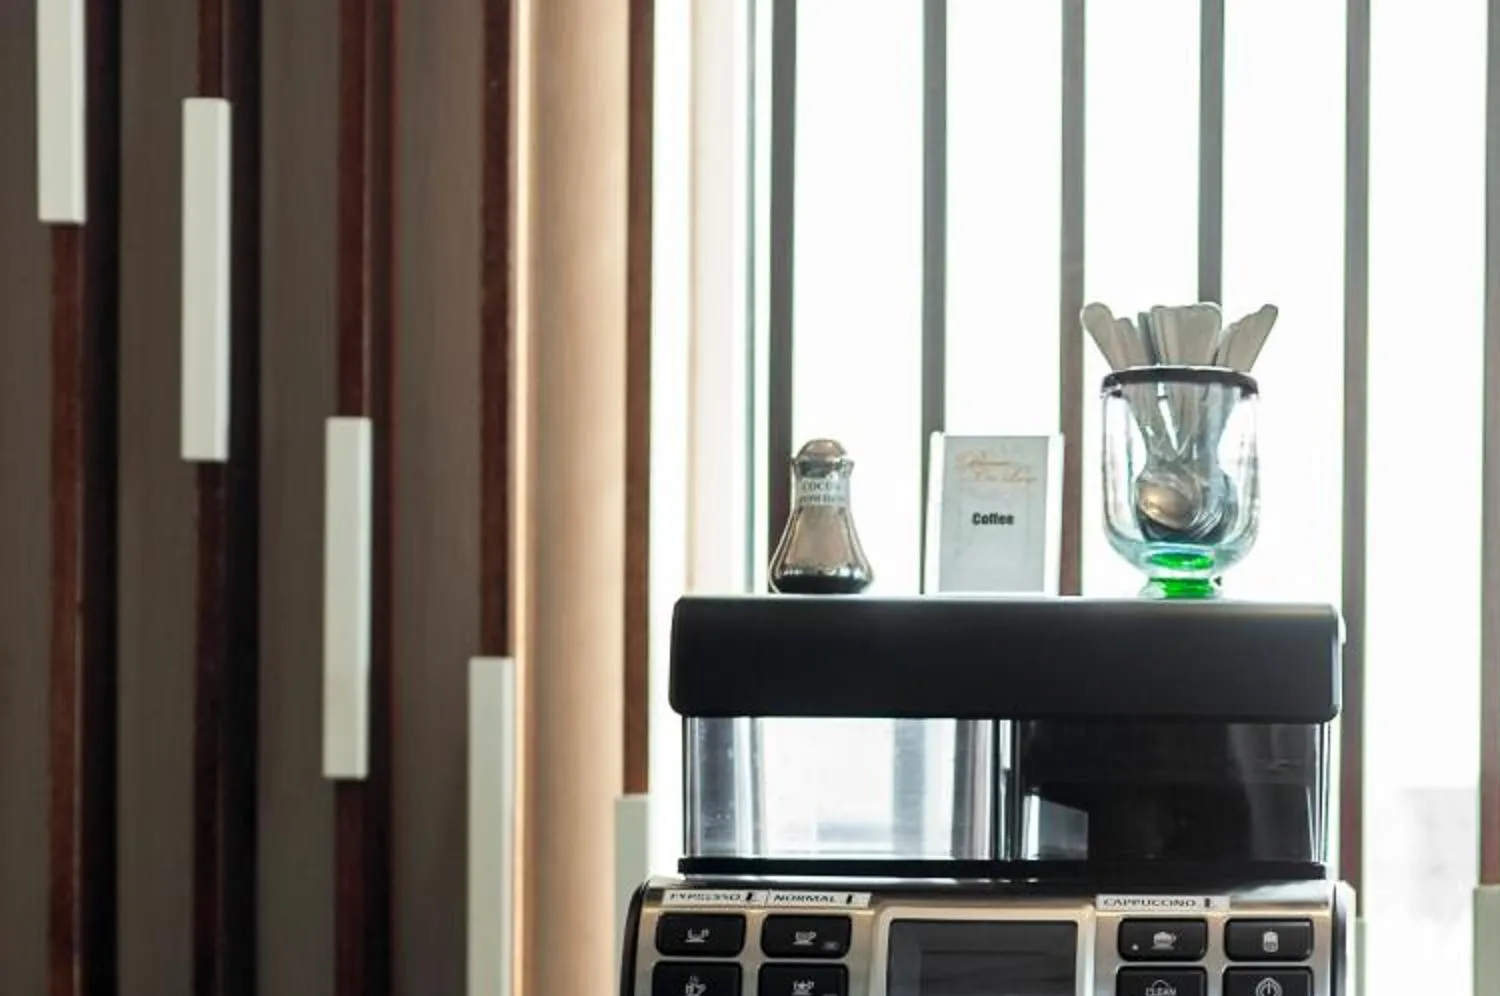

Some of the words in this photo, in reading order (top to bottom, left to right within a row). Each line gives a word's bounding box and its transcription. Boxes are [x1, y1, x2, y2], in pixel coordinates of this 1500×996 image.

[972, 512, 1015, 526] Coffee
[773, 893, 836, 903] NORMAL
[1102, 898, 1197, 907] CAPPUCCINO
